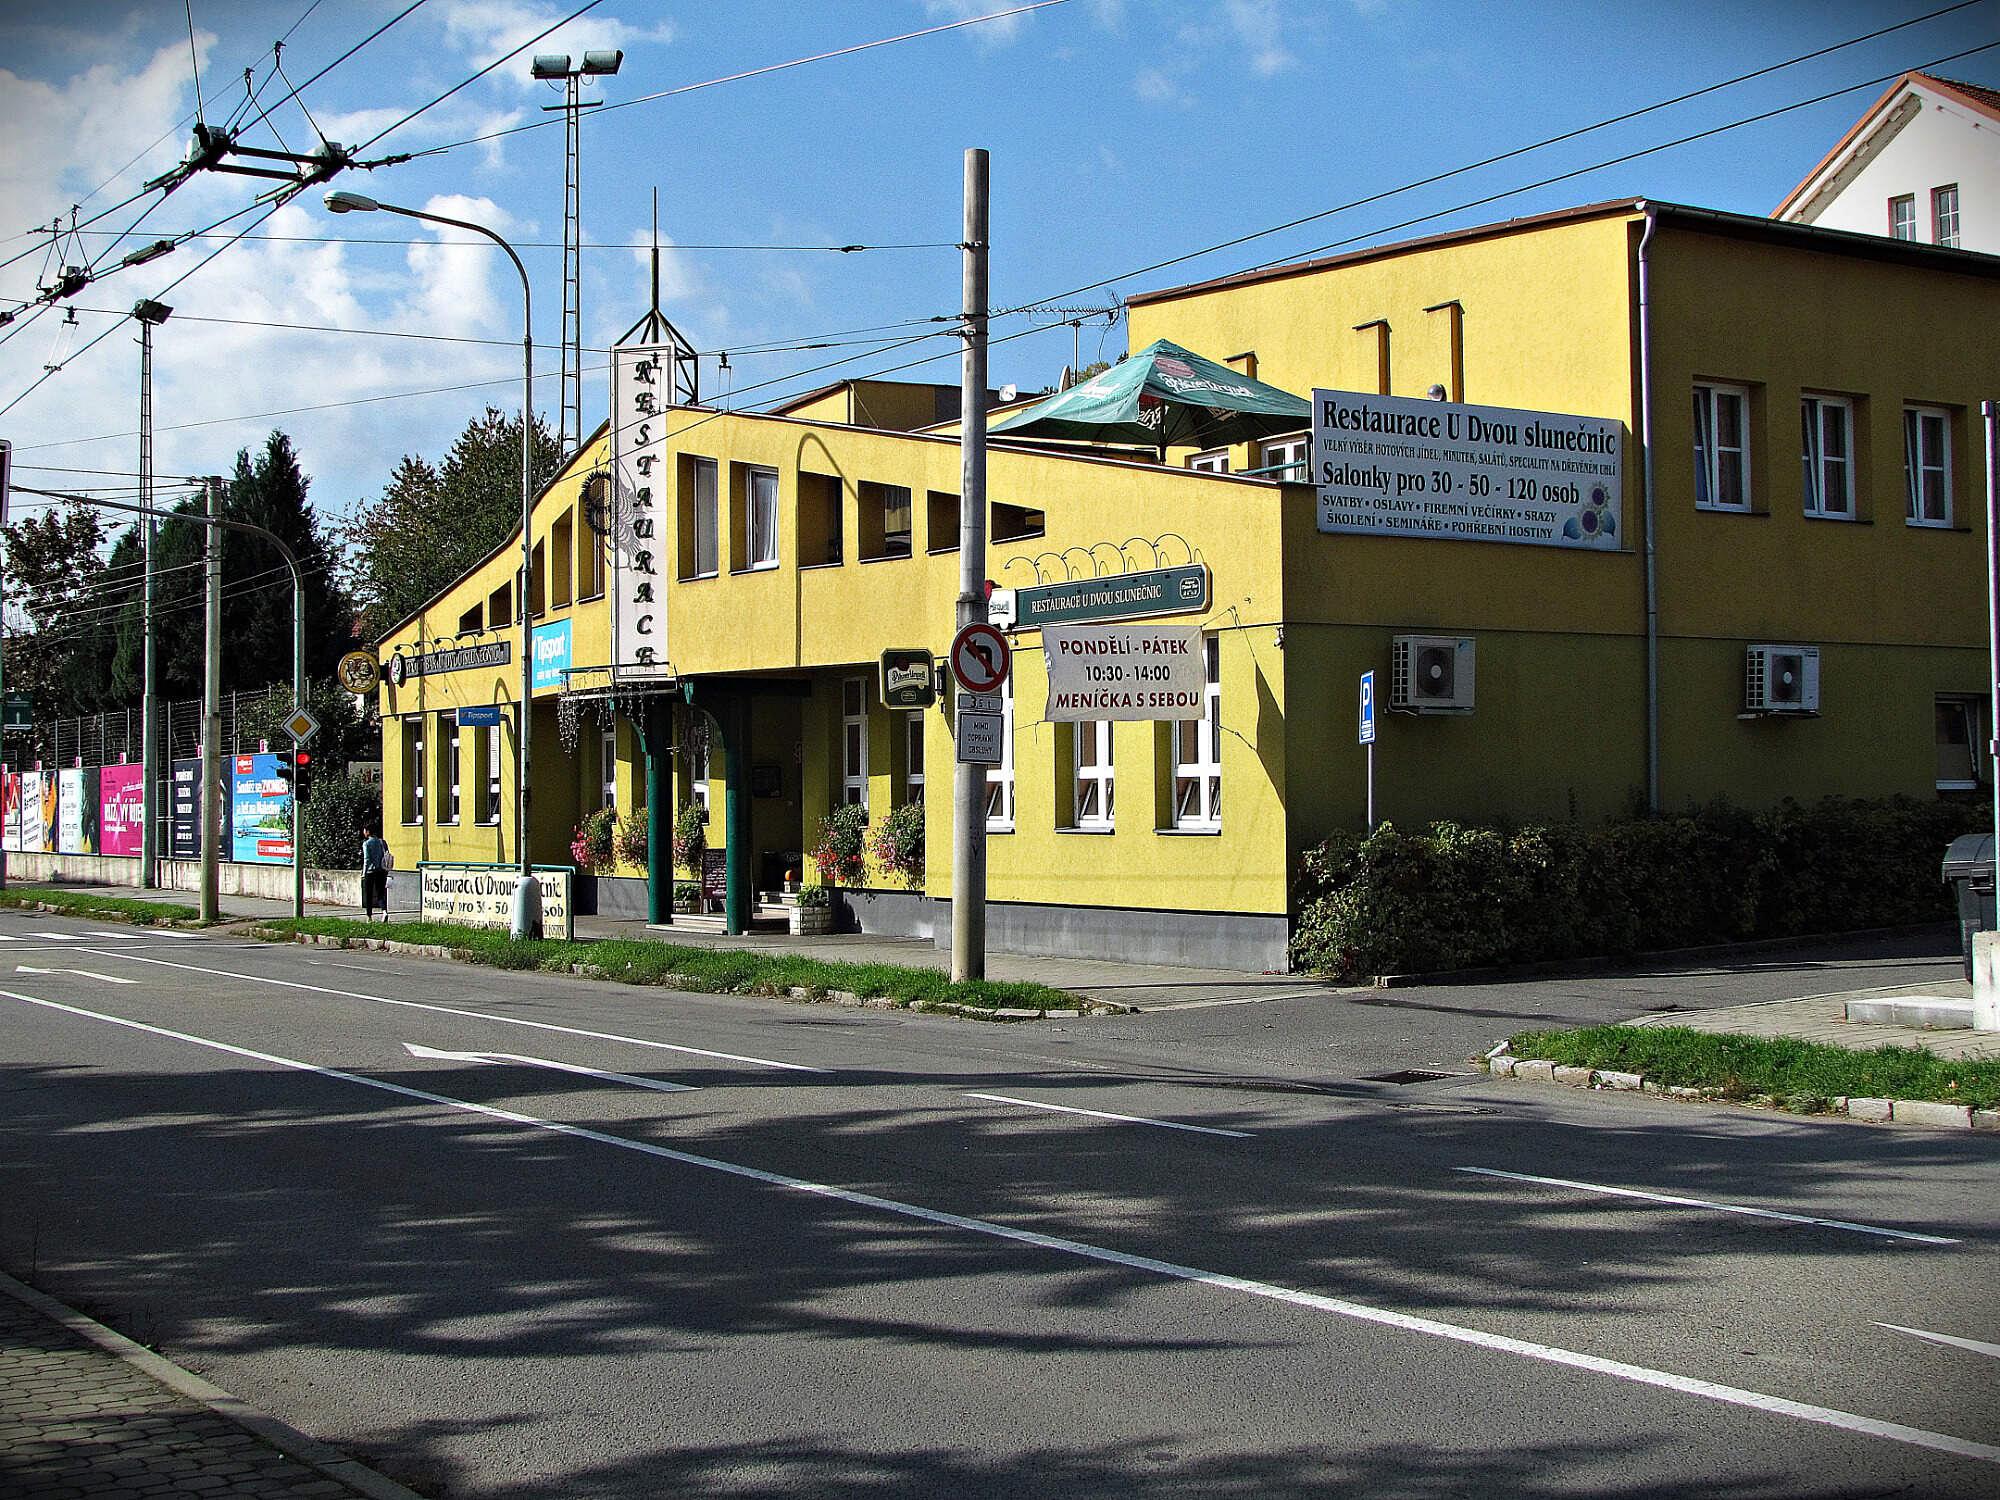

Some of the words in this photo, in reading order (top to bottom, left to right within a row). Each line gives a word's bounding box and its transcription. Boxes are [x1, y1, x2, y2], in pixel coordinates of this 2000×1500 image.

[1323, 400, 1441, 438] Restaurace
[1447, 413, 1460, 440] U
[1467, 415, 1518, 445] Dvou
[1524, 420, 1616, 454] slunečnic
[1323, 436, 1347, 452] VELKÝ
[1349, 438, 1373, 454] VÝBĚR
[1375, 441, 1415, 459] HOTOVÝCH
[1417, 443, 1441, 462] JÍDEL,
[1443, 449, 1477, 466] MINUTEK,
[1509, 455, 1549, 470] SPECIALITY
[1550, 459, 1561, 471] NA
[1323, 461, 1392, 495] Salonky
[1397, 472, 1426, 496] pro
[1431, 470, 1452, 493] 30
[1469, 474, 1490, 496] 50
[1507, 478, 1537, 501] 120
[1542, 482, 1579, 504] osob
[633, 360, 660, 667] RESTAURACE
[1322, 494, 1363, 508] SVATBY
[1373, 499, 1414, 511] OSLAVY
[1424, 502, 1468, 516] FIREMNÍ
[1471, 503, 1516, 520] VEČÍRKY
[1524, 510, 1557, 522] SRAZY
[1327, 509, 1376, 527] ŠKOLENÍ
[1385, 515, 1441, 531] SEMINÁŘE
[1452, 520, 1505, 536] POHŘEBNÍ
[1509, 526, 1553, 539] HOSTINY
[1031, 594, 1081, 614] RESTAURACE
[1082, 594, 1089, 608] U
[1090, 591, 1114, 607] DVOU
[1115, 583, 1162, 603] SLUNEČNIC
[537, 631, 566, 666] Tipsport
[1059, 635, 1131, 655] PONDĚLÍ
[1142, 635, 1189, 655] PÁTEK
[1085, 665, 1123, 681] 10:30
[1135, 665, 1171, 681] 14:00
[1056, 688, 1132, 708] MENÍČKA
[1136, 692, 1145, 708] S
[1149, 692, 1199, 708] SEBOU
[1362, 682, 1370, 721] P
[495, 901, 509, 915] 50
